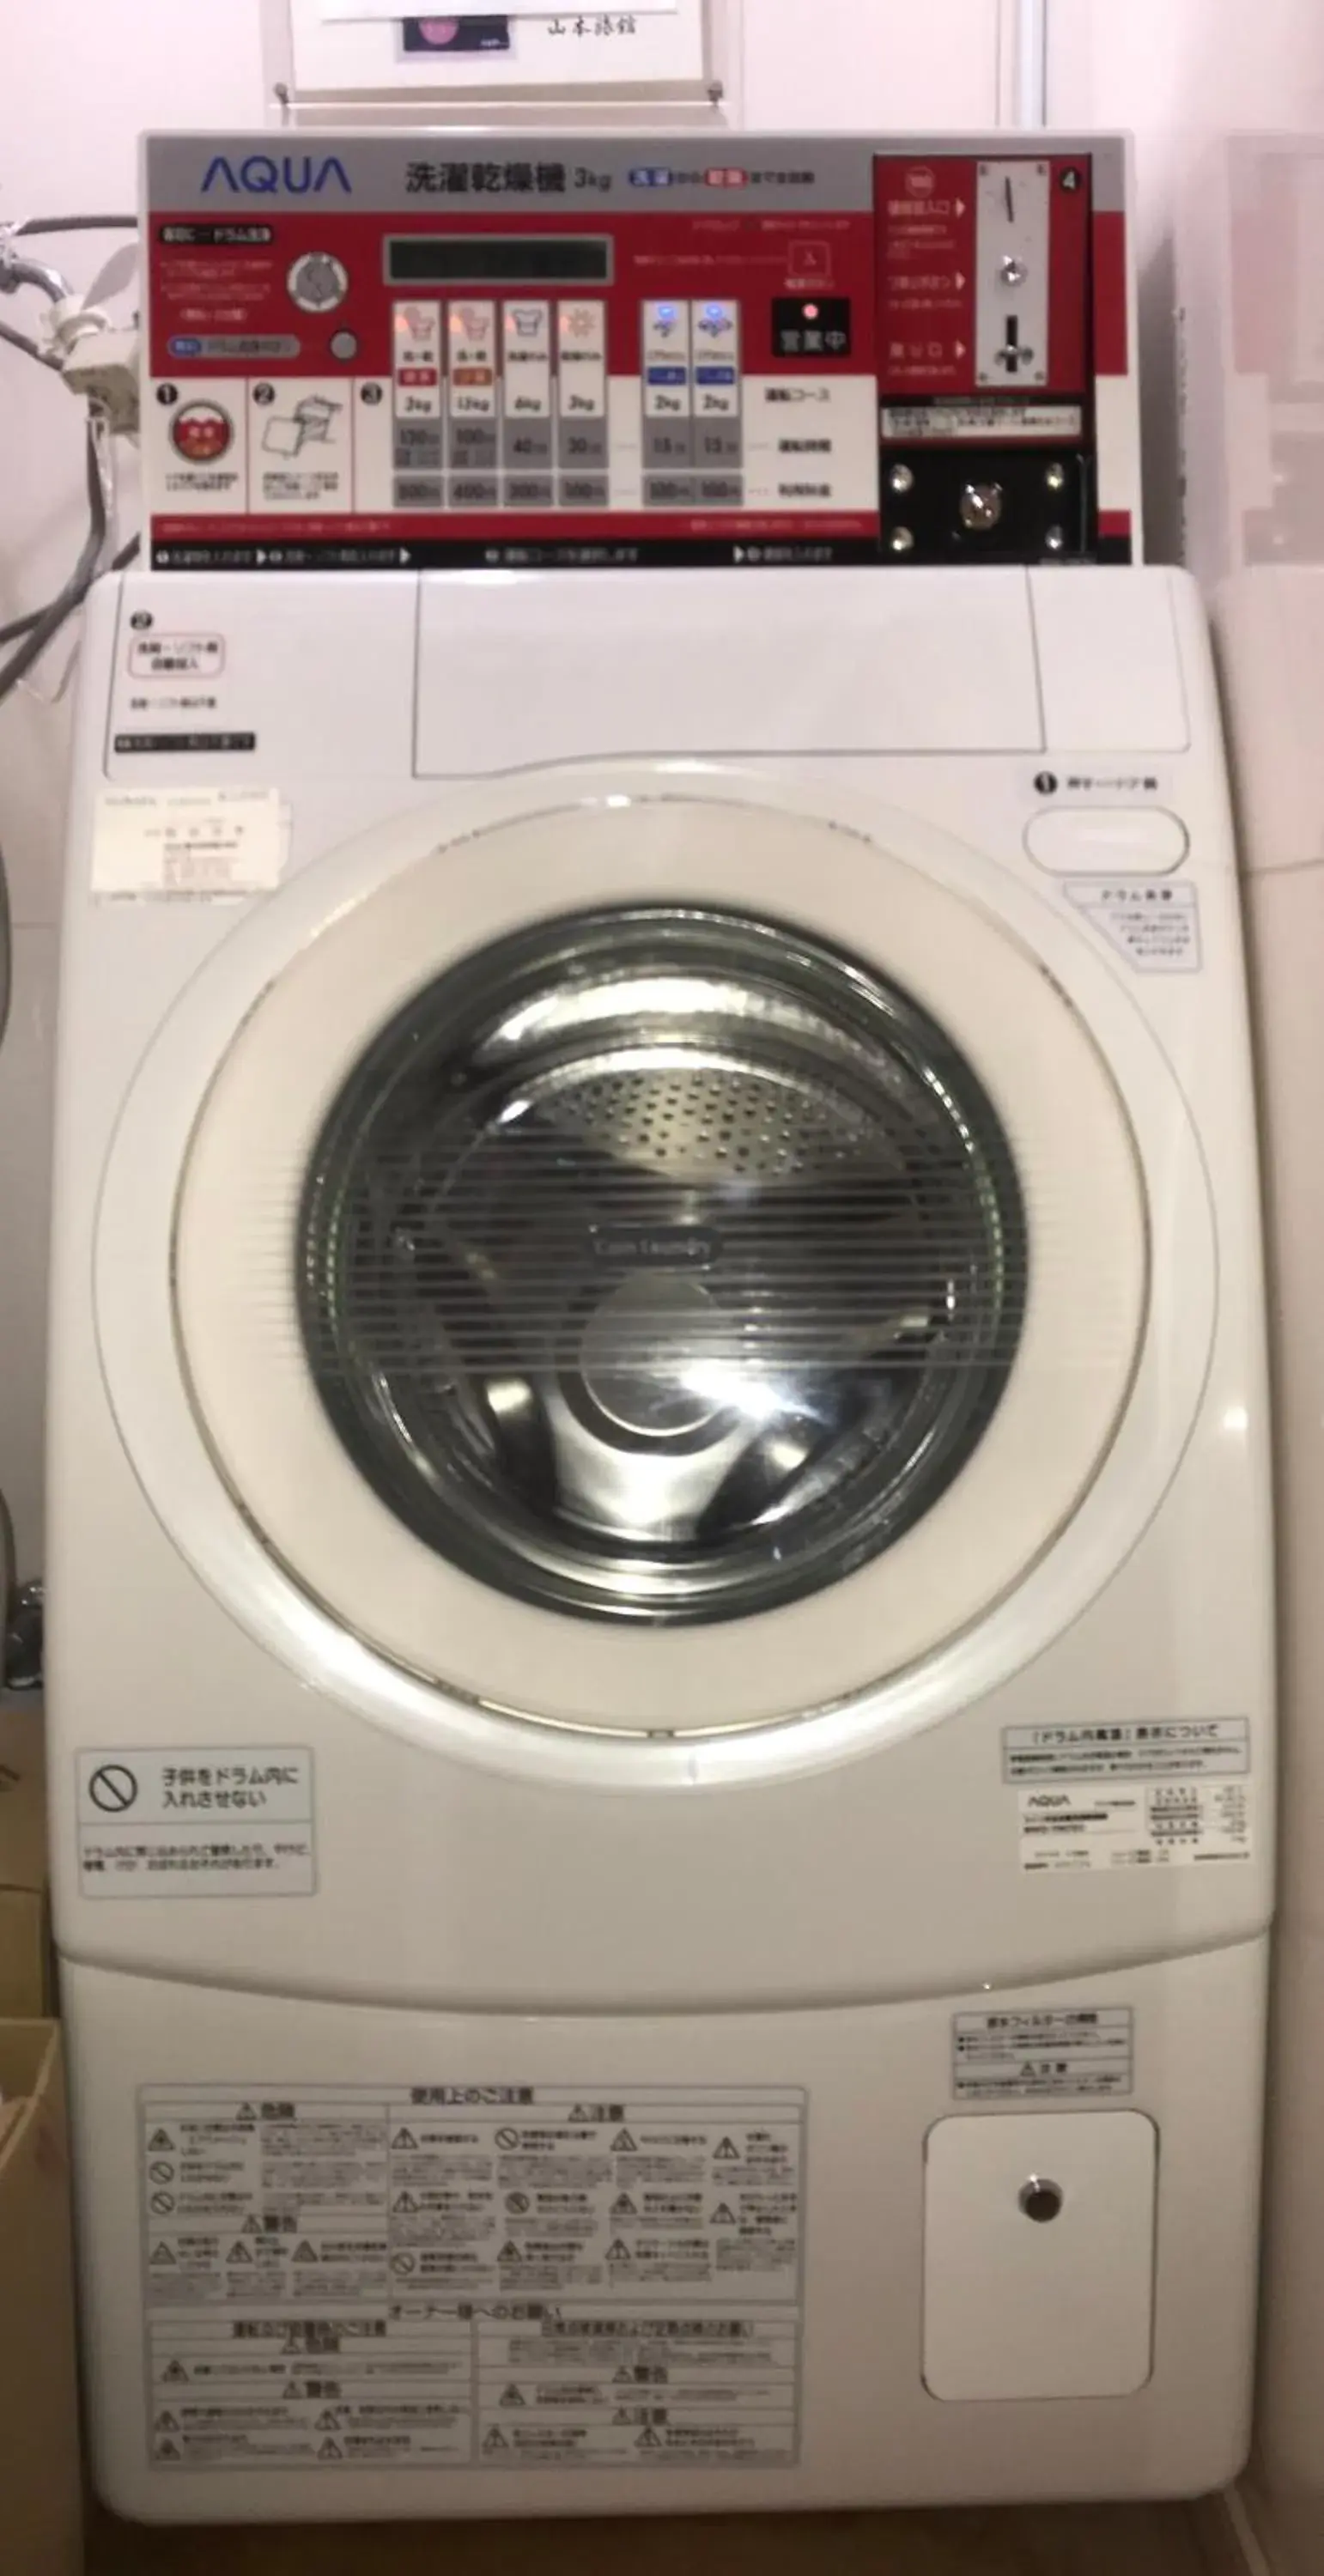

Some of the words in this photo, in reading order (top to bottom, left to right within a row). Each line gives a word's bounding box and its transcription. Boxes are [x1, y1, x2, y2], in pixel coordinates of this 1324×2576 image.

[201, 155, 352, 193] AQUA
[405, 161, 567, 193] 洗濯乾燥機
[161, 1766, 299, 1787] 子供をドラム内に
[161, 1789, 267, 1809] 入れさせない
